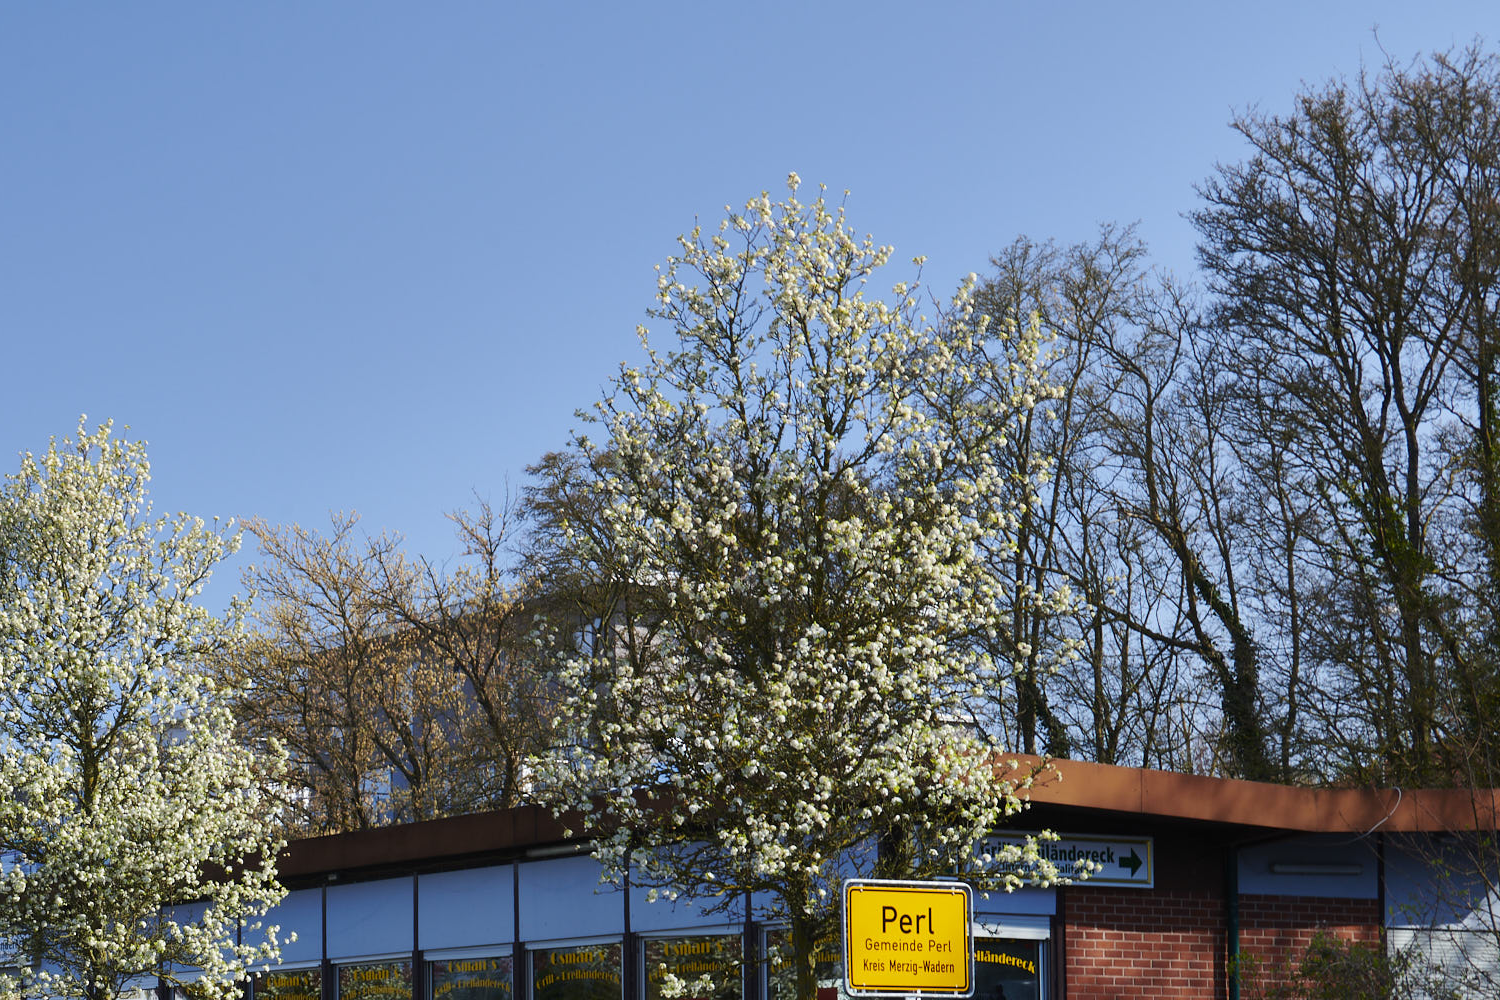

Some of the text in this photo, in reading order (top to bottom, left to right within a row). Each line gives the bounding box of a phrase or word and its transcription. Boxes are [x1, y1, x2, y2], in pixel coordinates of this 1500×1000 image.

[882, 906, 934, 934] Perl
[865, 938, 952, 952] Gemeinde Perl
[863, 959, 955, 976] Kreis Merzig-Wadern
